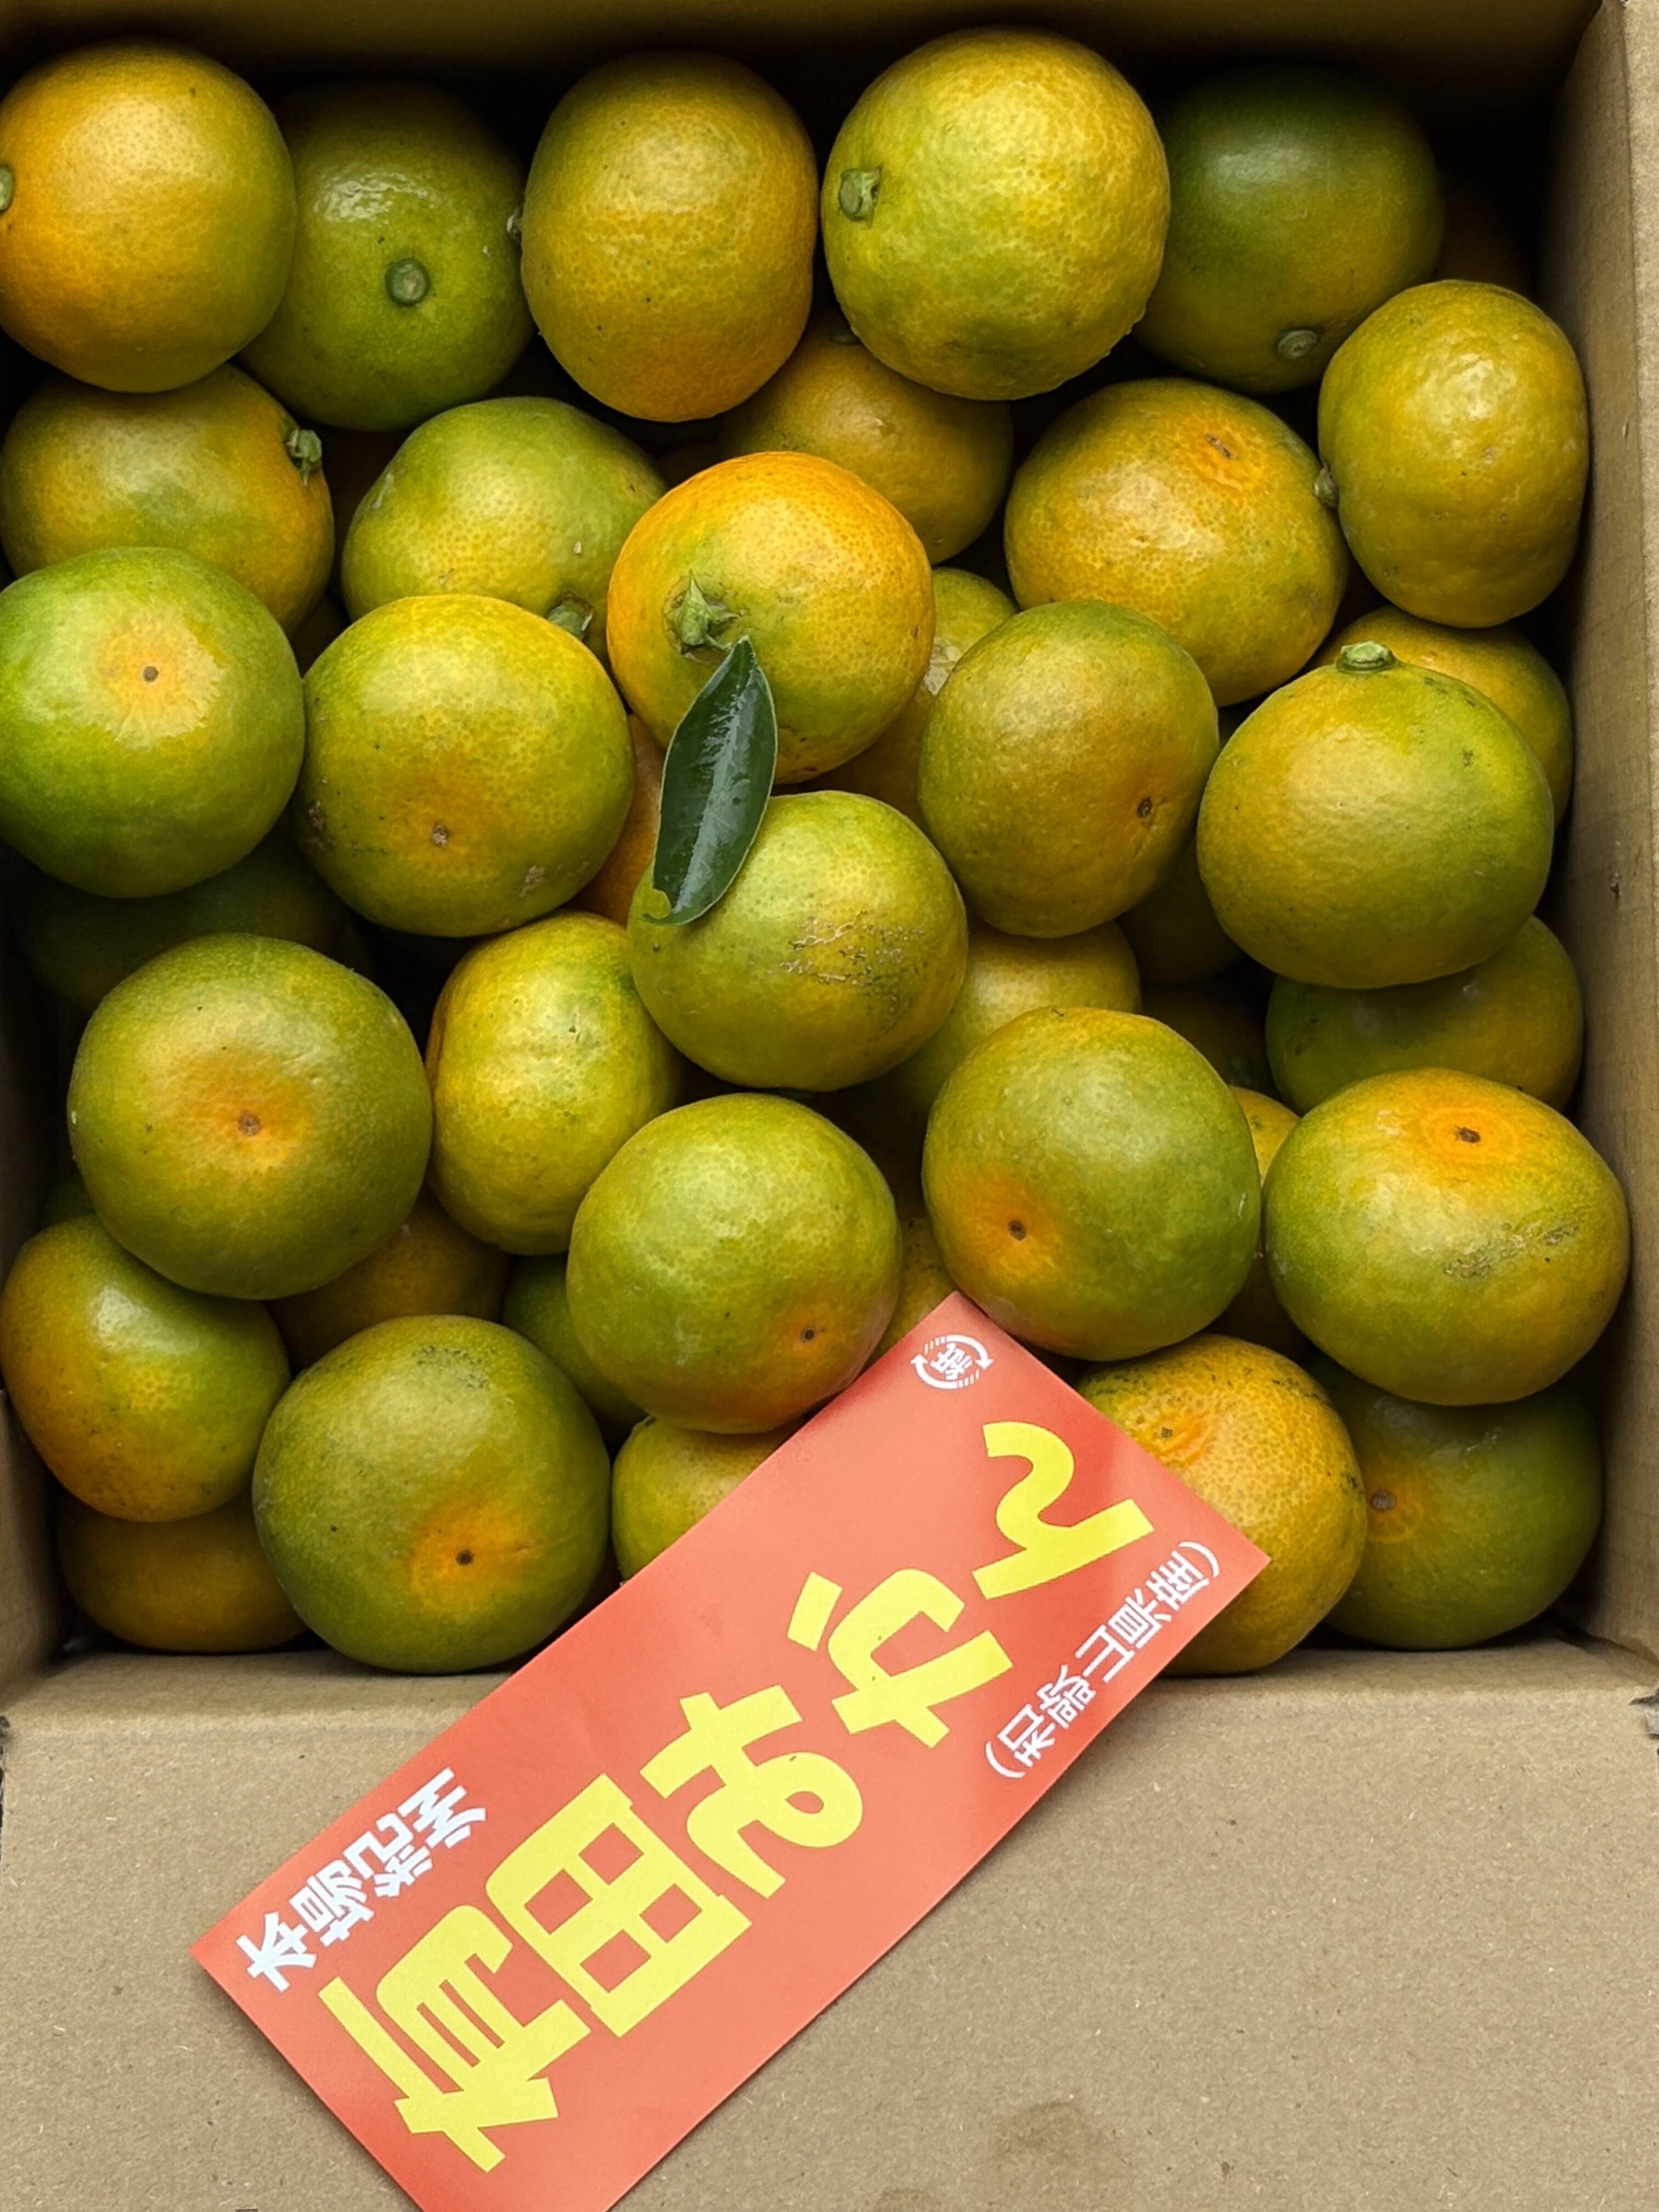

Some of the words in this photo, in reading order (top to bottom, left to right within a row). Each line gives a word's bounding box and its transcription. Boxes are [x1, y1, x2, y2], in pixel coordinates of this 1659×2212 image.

[930, 1342, 973, 1380] 紙
[985, 1541, 1221, 1779] (和歌山県産)
[236, 1767, 487, 1994] 本場紀州
[319, 1421, 1154, 2172] 有田みかん
